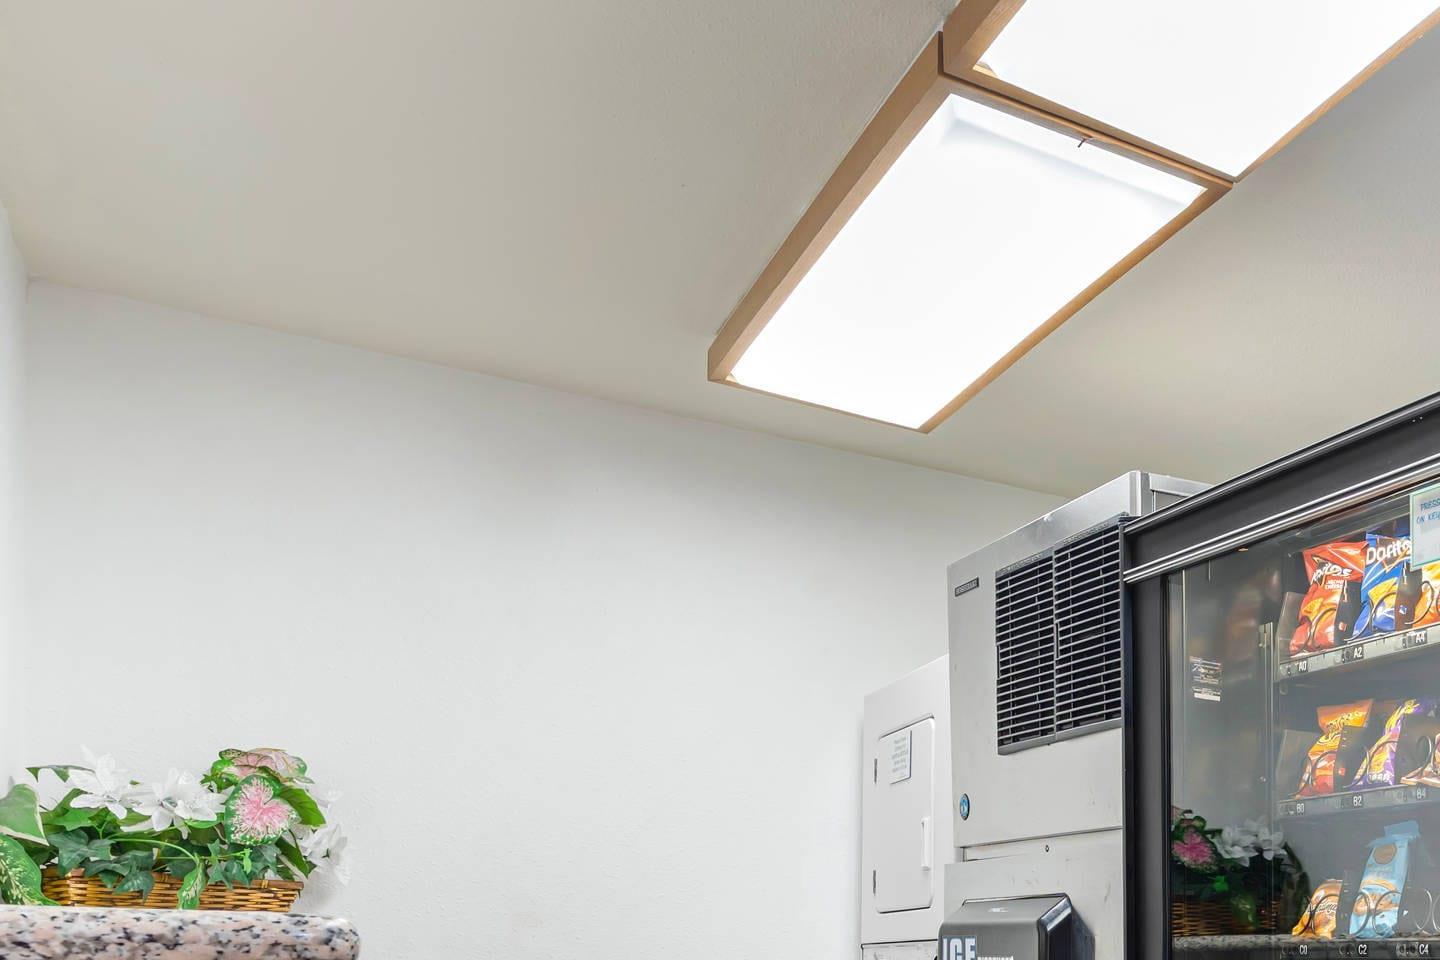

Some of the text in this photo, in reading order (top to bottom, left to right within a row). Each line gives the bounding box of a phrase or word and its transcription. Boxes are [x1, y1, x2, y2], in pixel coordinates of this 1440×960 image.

[1420, 498, 1440, 511] PRESS
[1415, 632, 1425, 643] A4
[1354, 646, 1363, 658] A2
[1358, 944, 1367, 955] C2
[1419, 945, 1429, 955] C4
